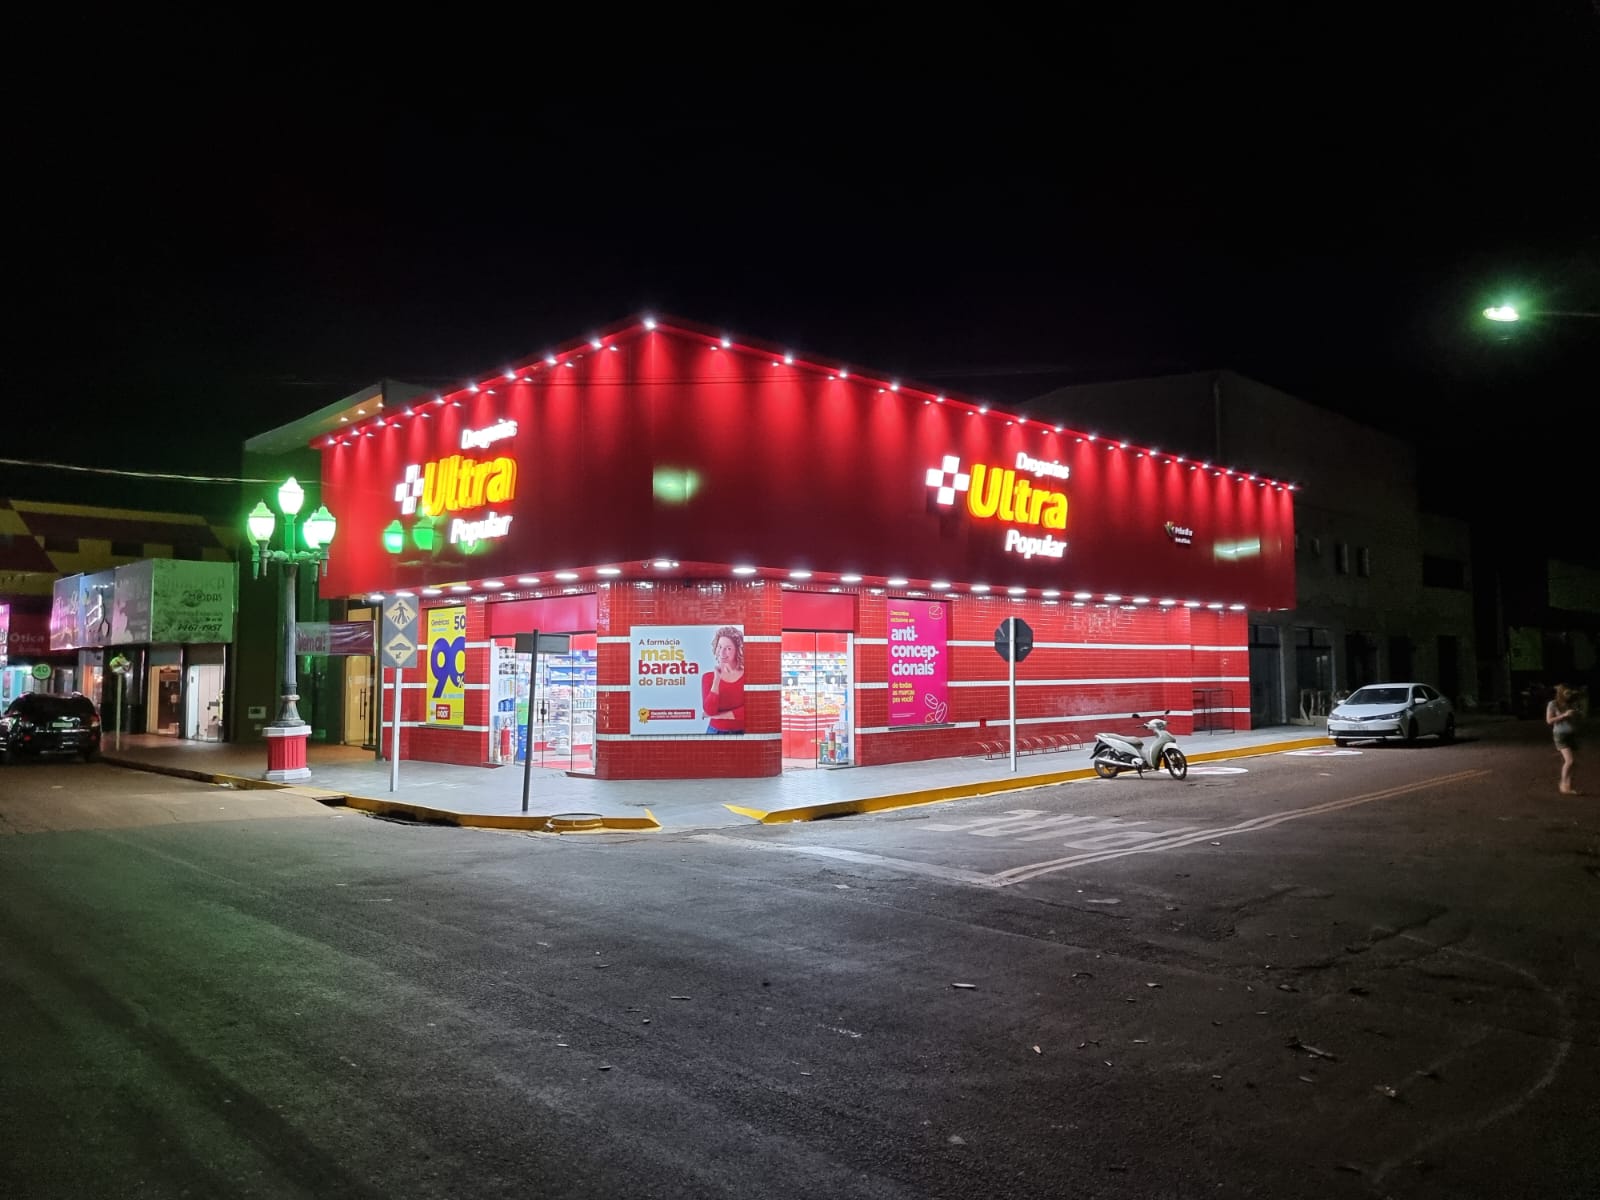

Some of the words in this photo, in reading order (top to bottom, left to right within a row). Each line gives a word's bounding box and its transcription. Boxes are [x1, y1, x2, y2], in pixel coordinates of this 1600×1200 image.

[422, 454, 517, 516] Ultra
[967, 464, 1069, 529] Ultra
[450, 511, 513, 547] Popular
[1004, 529, 1067, 559] Popular
[891, 625, 919, 641] anti-
[647, 638, 681, 646] farmácia
[641, 646, 685, 661] mais
[891, 644, 940, 661] concep-
[639, 659, 699, 675] barata
[639, 677, 653, 686] do
[656, 677, 686, 686] Brasil
